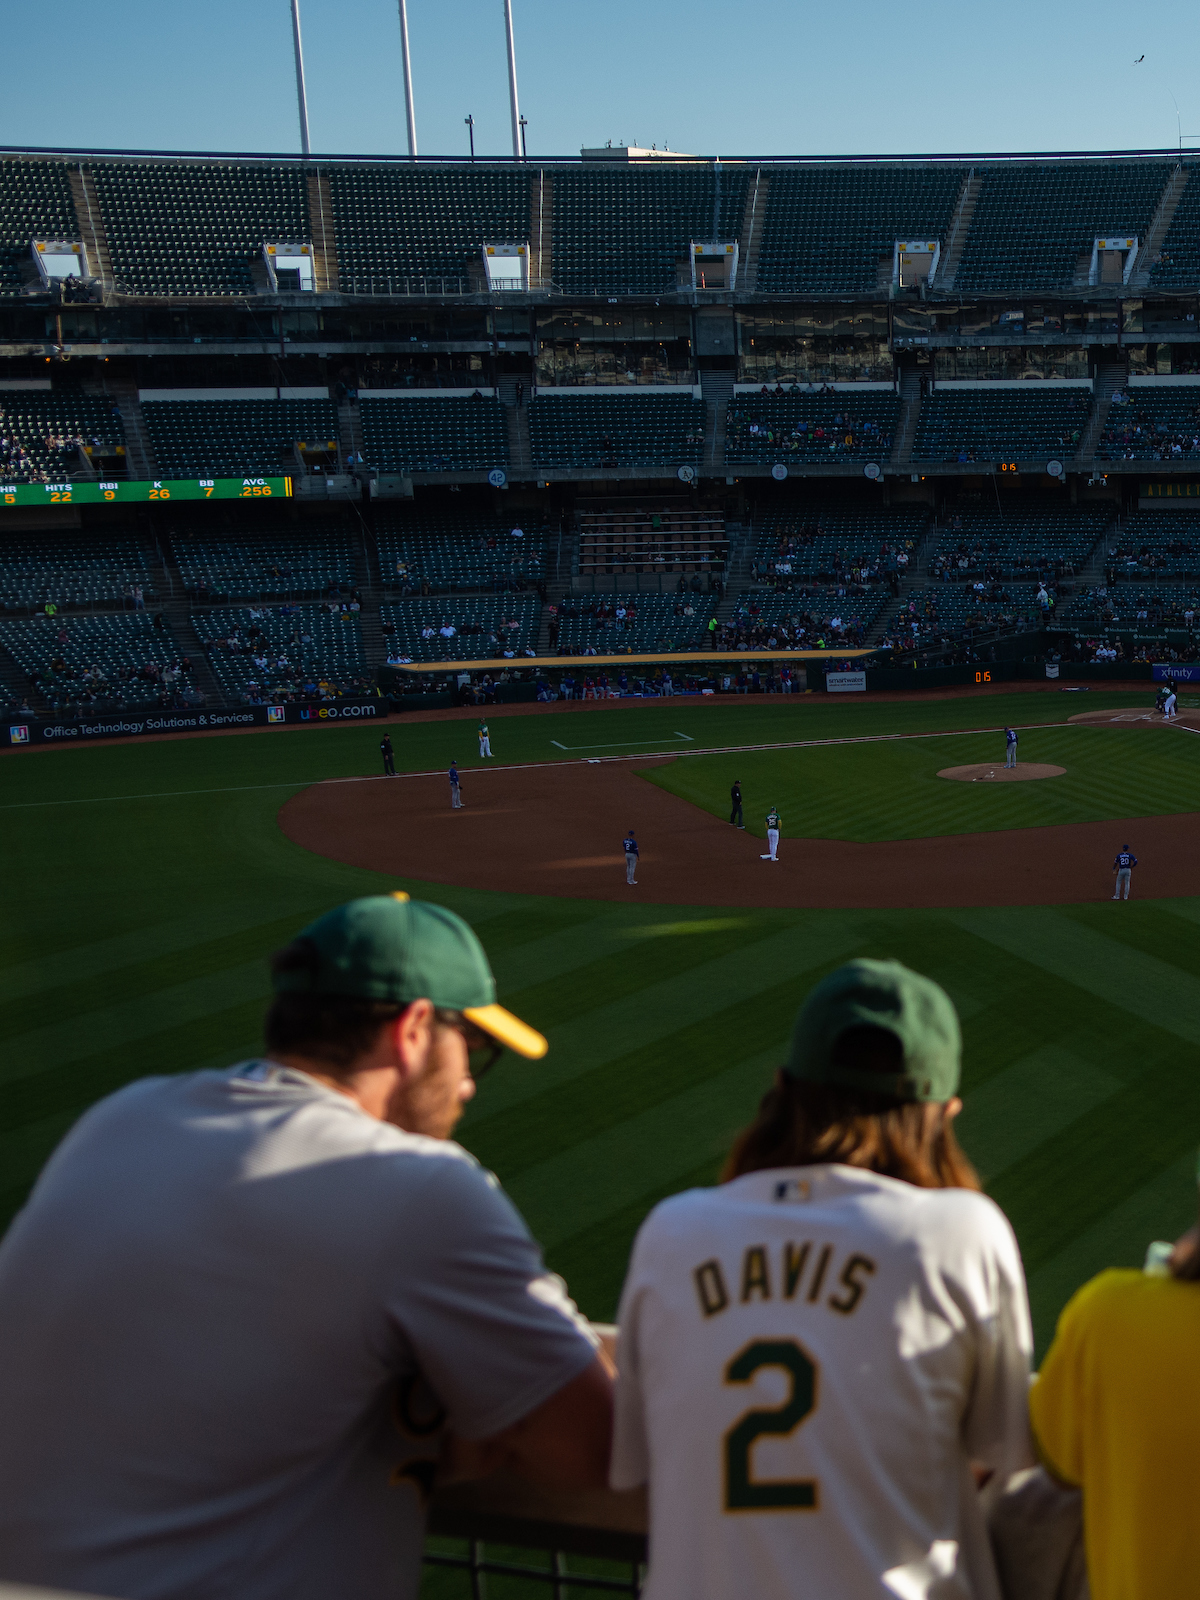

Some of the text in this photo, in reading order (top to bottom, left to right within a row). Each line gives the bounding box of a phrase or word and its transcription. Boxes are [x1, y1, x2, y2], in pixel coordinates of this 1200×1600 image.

[0, 478, 268, 493] HR HITS RBI K BB AVG.
[491, 473, 502, 483] 42
[4, 486, 272, 504] 5 22 9 26 7 .256
[1160, 666, 1193, 680] xfinity
[300, 705, 376, 720] ubeo.com
[43, 713, 255, 738] Office Technology Solutions & Services
[1120, 857, 1130, 866] 20
[693, 1240, 876, 1319] DAVIS
[722, 1334, 820, 1512] 2
